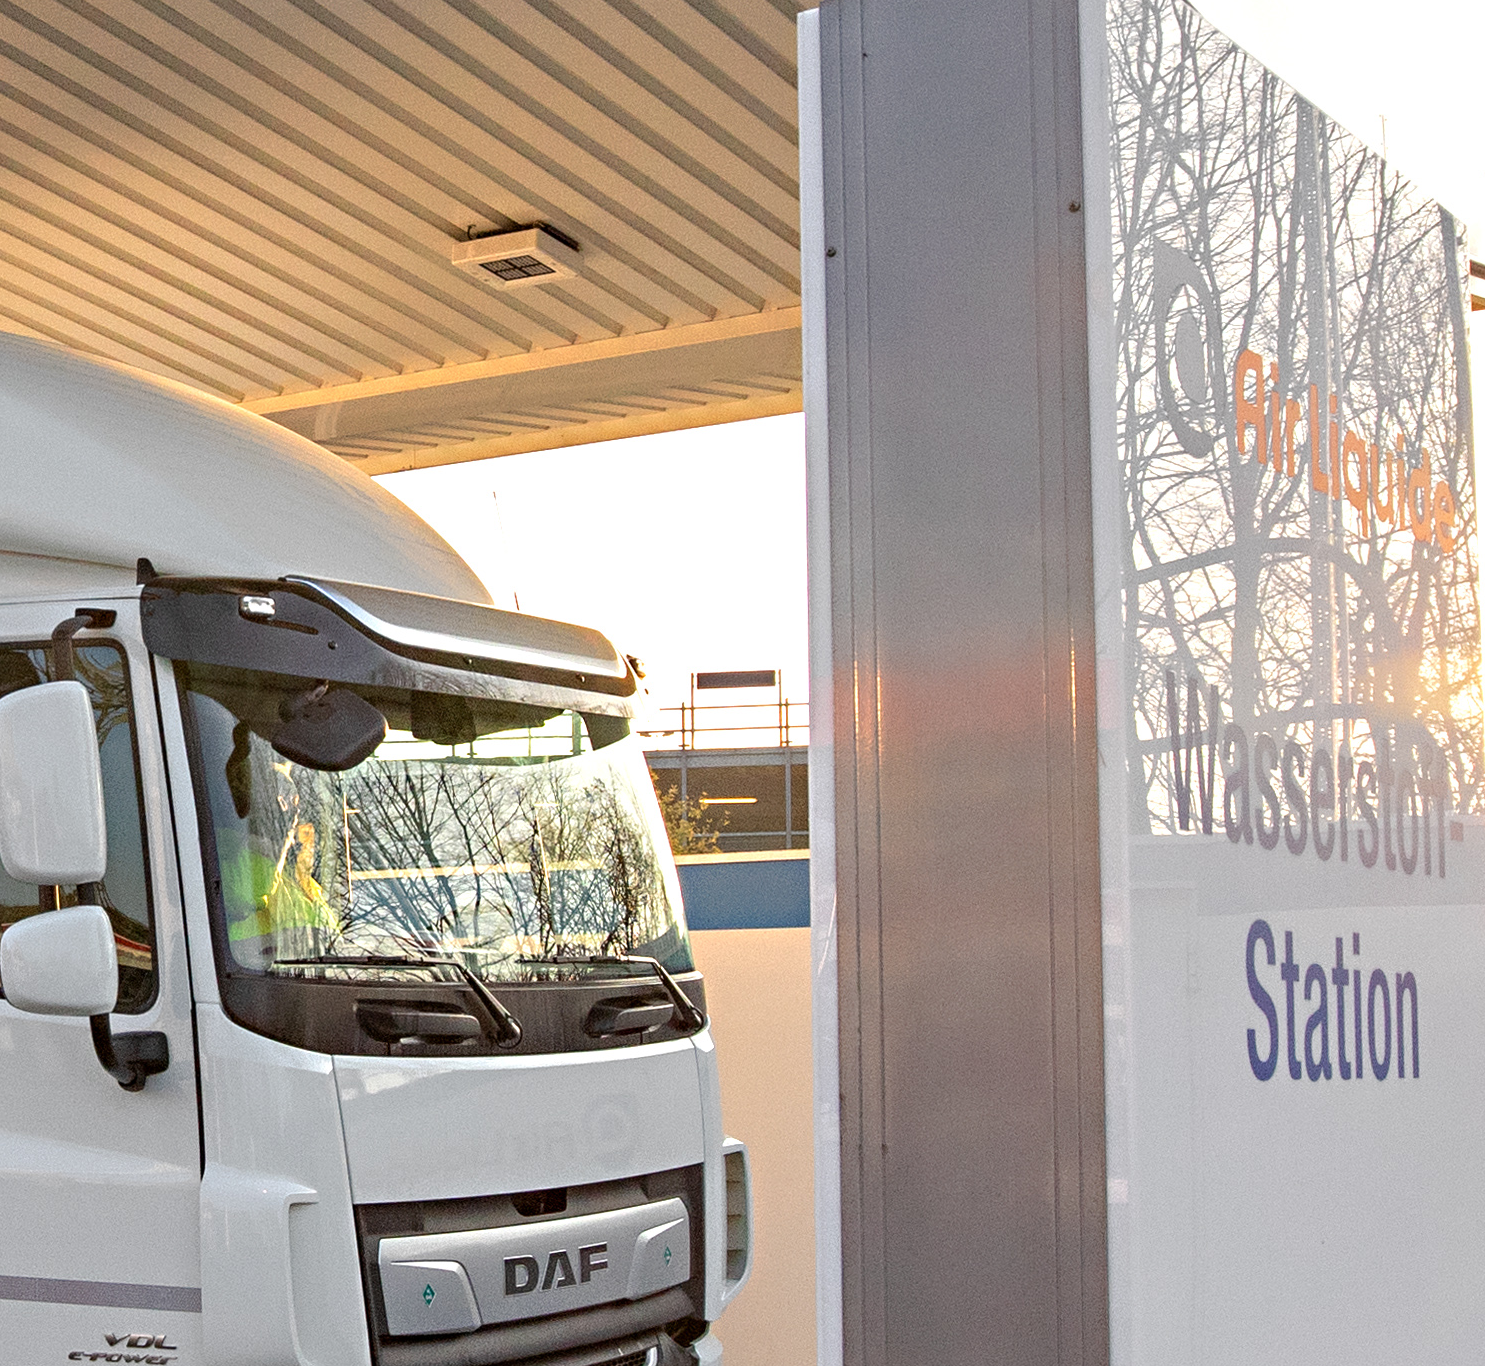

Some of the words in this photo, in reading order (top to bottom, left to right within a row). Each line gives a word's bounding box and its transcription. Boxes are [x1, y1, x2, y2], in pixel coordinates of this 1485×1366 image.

[1235, 348, 1301, 478] Air
[1309, 383, 1455, 554] Liquide
[1245, 918, 1420, 1082] Station
[503, 1241, 609, 1297] DAF
[104, 1333, 177, 1350] VDL
